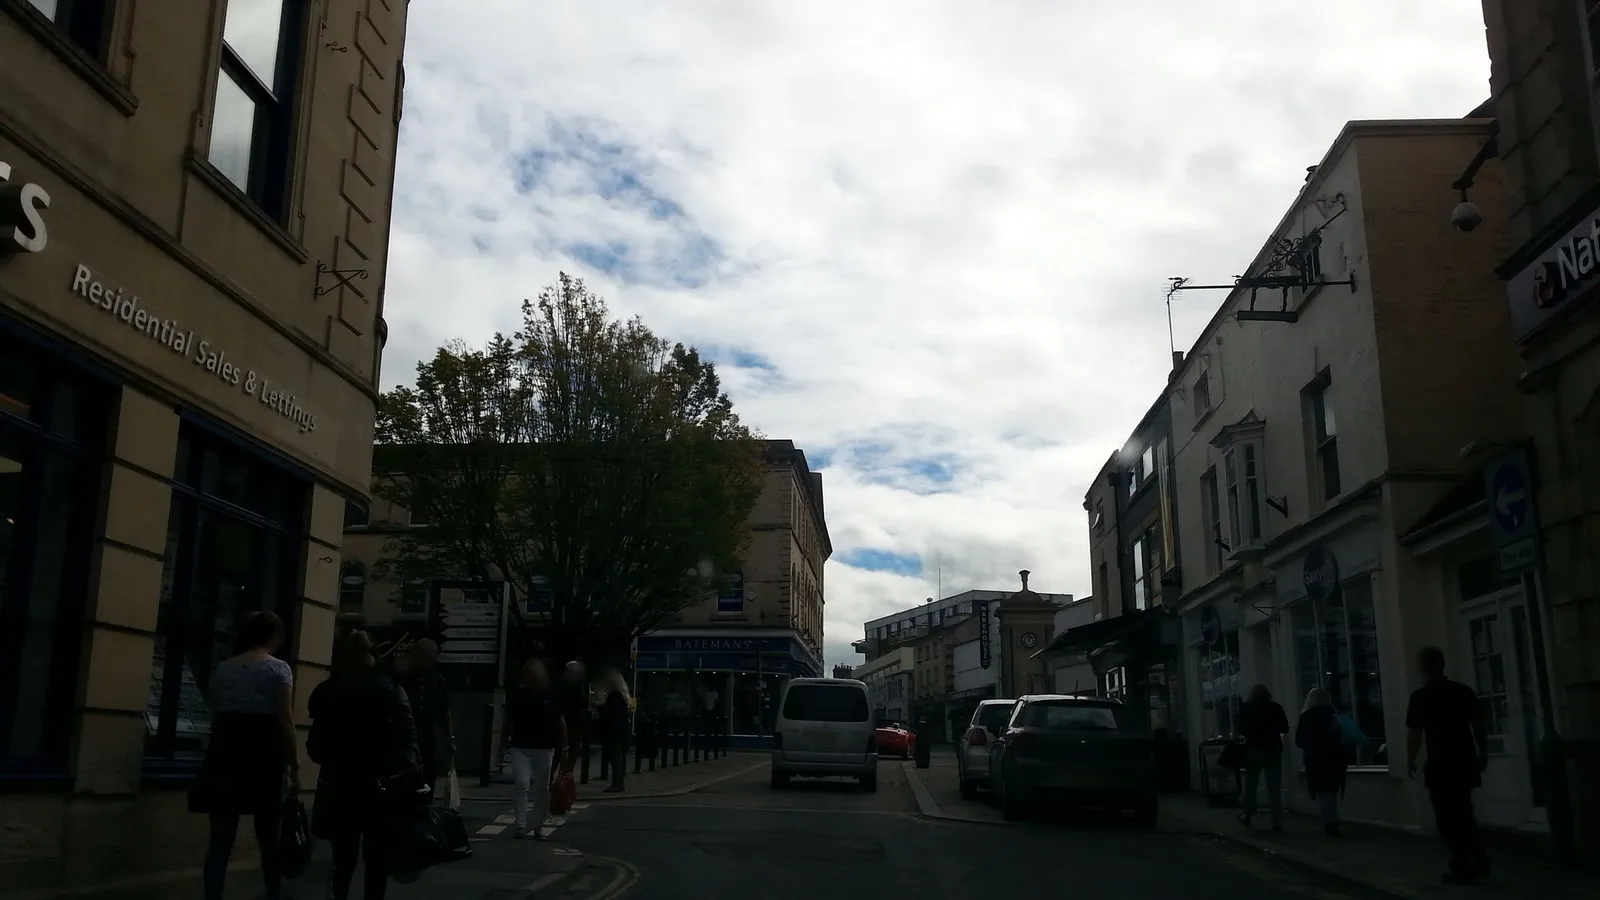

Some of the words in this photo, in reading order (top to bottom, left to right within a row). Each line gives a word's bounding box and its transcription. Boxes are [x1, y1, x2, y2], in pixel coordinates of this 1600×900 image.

[72, 263, 193, 356] Residential
[195, 339, 241, 385] Sales
[244, 370, 257, 394] &
[260, 378, 318, 432] Lettings
[674, 638, 752, 650] BATEMANS
[980, 605, 989, 659] WAREHOUSE
